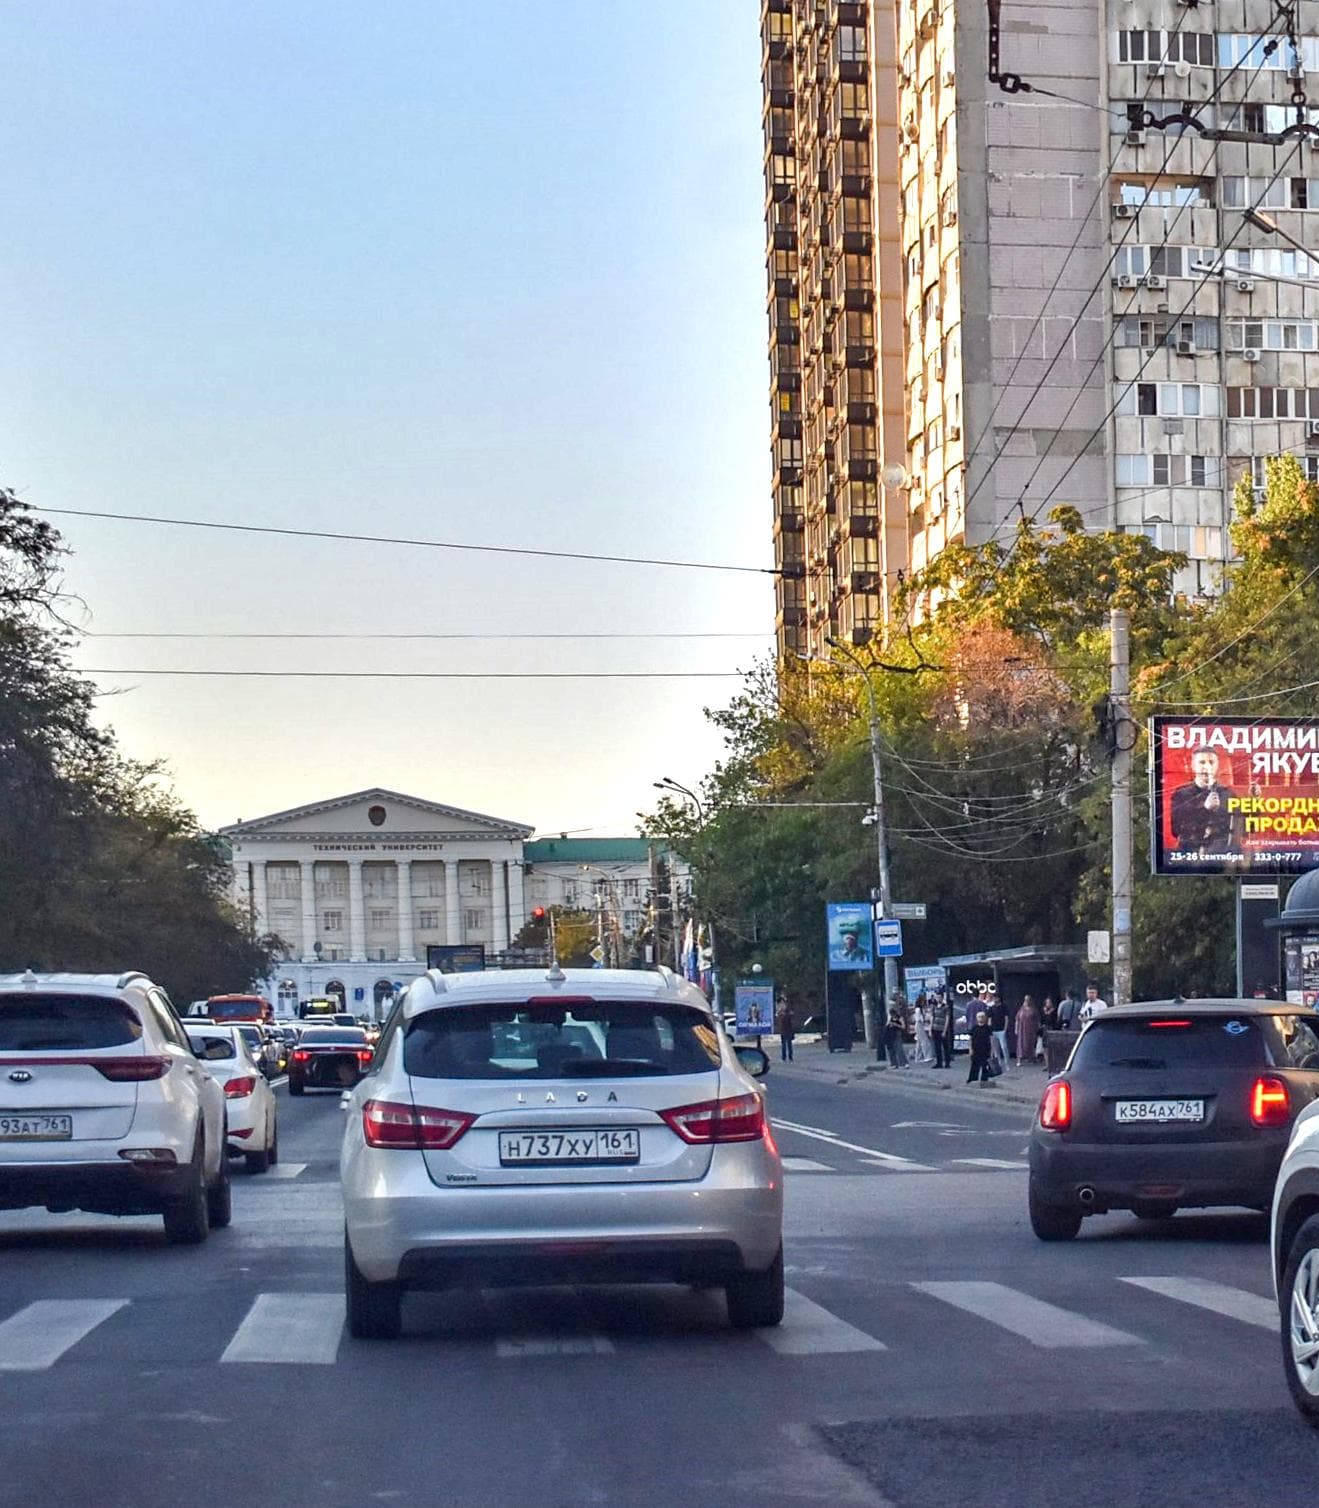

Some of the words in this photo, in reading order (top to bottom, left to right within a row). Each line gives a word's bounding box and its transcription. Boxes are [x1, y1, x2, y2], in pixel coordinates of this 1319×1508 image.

[1199, 852, 1245, 862] сентября
[1254, 852, 1302, 861] 333-0-777
[517, 1091, 618, 1103] LADA
[1120, 1104, 1175, 1117] К584АХ
[1179, 1102, 1201, 1113] 761
[43, 1118, 68, 1129] 761
[508, 1135, 593, 1157] Н737ХУ
[600, 1132, 633, 1149] 161
